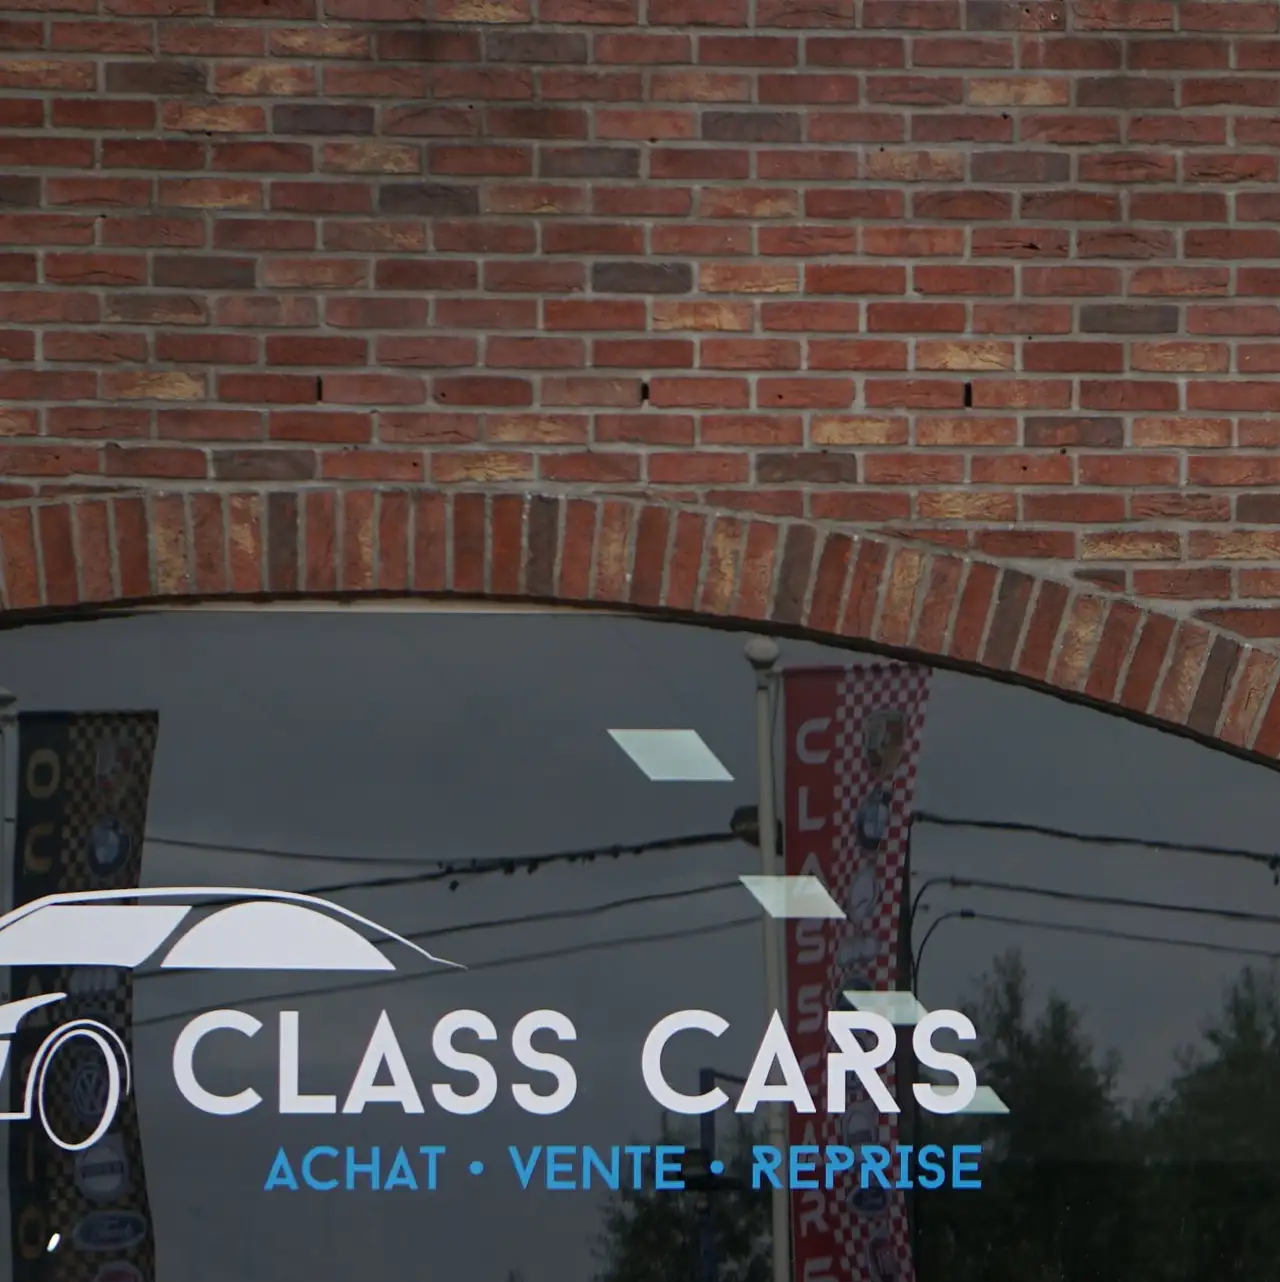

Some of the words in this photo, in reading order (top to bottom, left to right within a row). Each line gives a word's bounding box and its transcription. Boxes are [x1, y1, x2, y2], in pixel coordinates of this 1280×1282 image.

[173, 1009, 577, 1114] CLASS
[642, 1009, 977, 1114] CARS
[264, 1144, 447, 1192] ACHAT
[508, 1144, 686, 1192] VENTE
[751, 1144, 985, 1191] REPRISE
